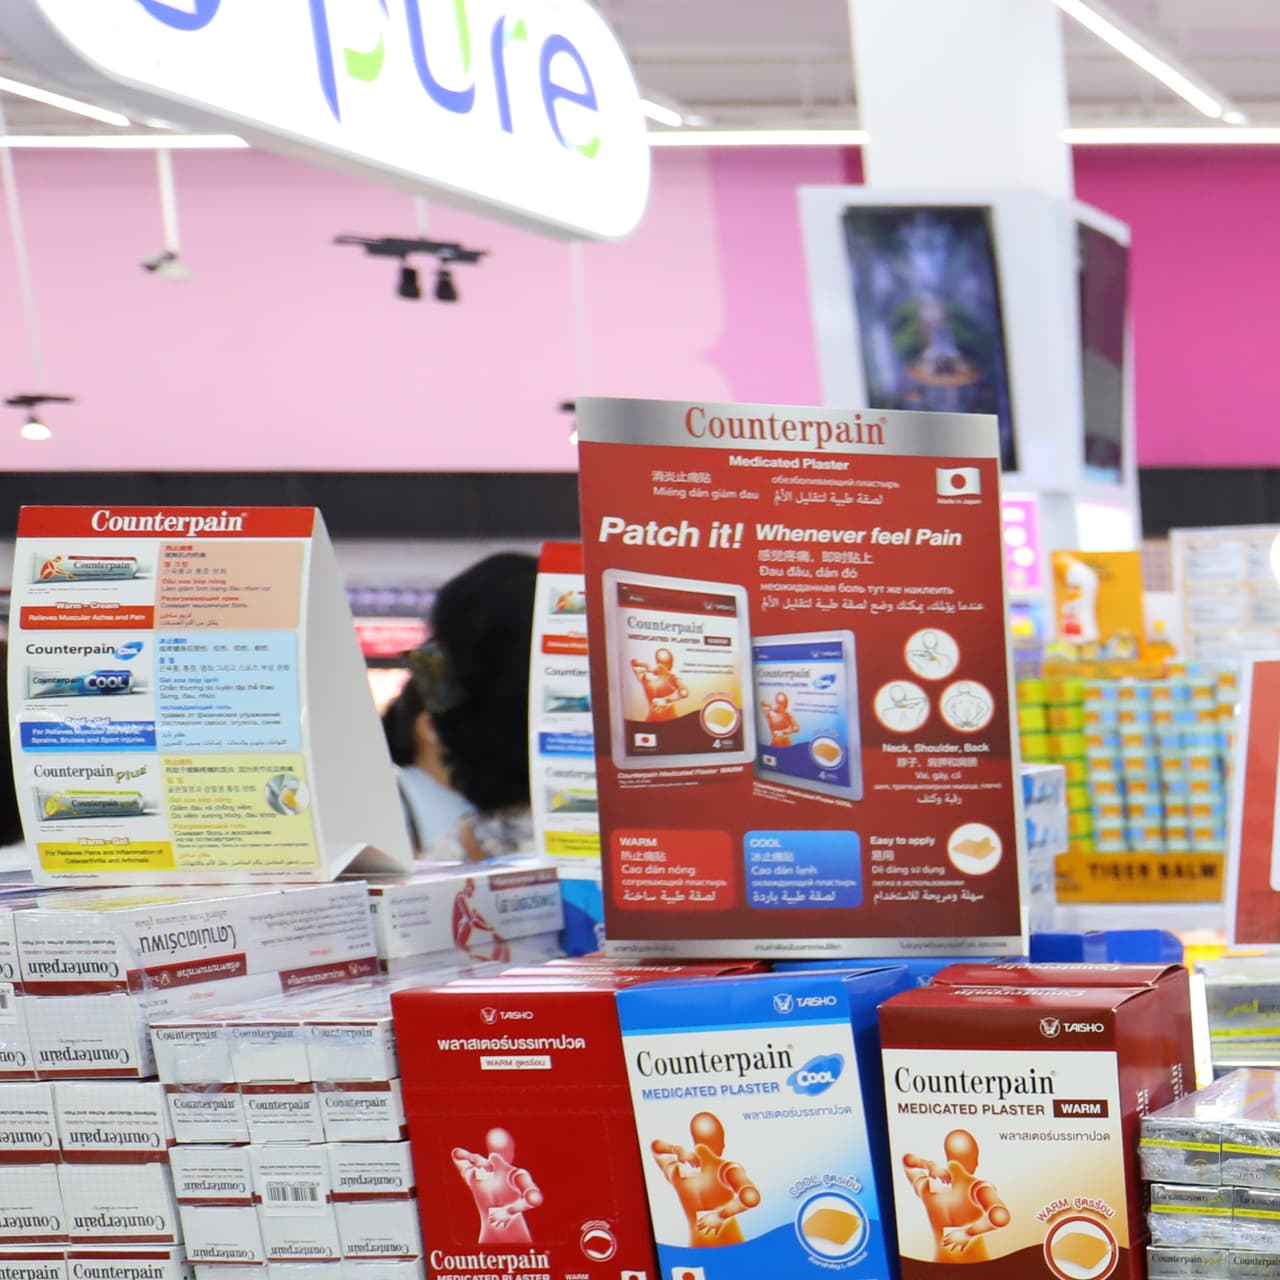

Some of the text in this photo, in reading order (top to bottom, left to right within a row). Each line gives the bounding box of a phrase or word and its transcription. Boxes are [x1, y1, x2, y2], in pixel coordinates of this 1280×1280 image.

[306, 0, 601, 159] pure
[685, 406, 885, 448] Counterpain
[729, 456, 849, 472] Medicated Plaster
[91, 509, 243, 536] Counterpain
[599, 517, 744, 549] Patch it!
[756, 524, 962, 546] Whenever feel Pain
[26, 644, 115, 656] Counterpain
[883, 743, 990, 753] Neck, Shoulder, Back
[34, 765, 113, 779] Counterpain
[620, 837, 657, 847] WARM
[870, 836, 935, 848] Easy to apply
[28, 958, 120, 979] Counterpain
[796, 995, 837, 1009] TAISHO
[437, 1034, 586, 1054] พลาสเตอร์บรรเทาปวด
[636, 1045, 794, 1079] Counterpain
[796, 1070, 835, 1087] COOL
[894, 1066, 1055, 1097] Counterpain
[898, 1102, 1101, 1117] MEDICATED PLASTER WARM
[999, 1128, 1111, 1144] พลาสเตอร์บรรเทาปวด
[430, 1249, 550, 1275] Counterpain
